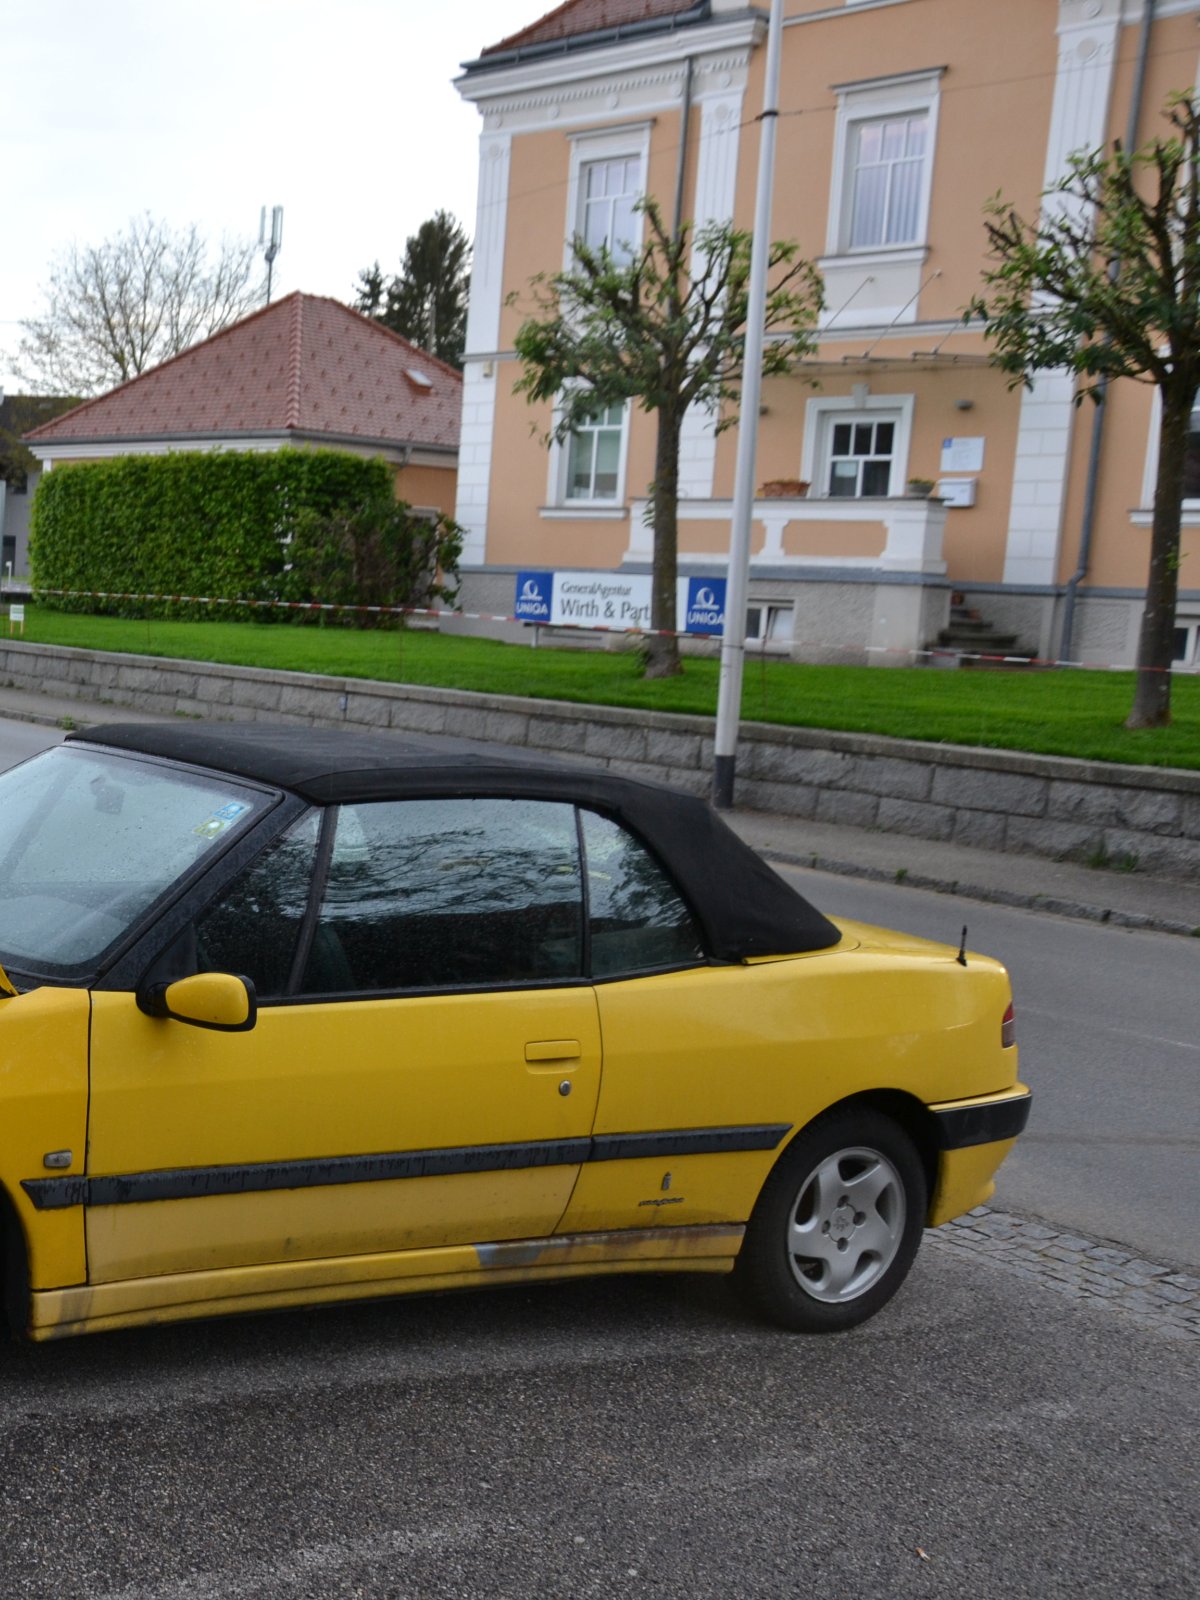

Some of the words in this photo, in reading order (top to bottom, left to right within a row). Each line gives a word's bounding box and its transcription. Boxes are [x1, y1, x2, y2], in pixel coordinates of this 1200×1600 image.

[561, 581, 632, 600] GeneralAgentur
[516, 602, 548, 615] UNIQA
[561, 600, 599, 618] Wirth
[604, 602, 615, 618] &
[620, 601, 650, 622] Part
[688, 611, 724, 625] UNIQA
